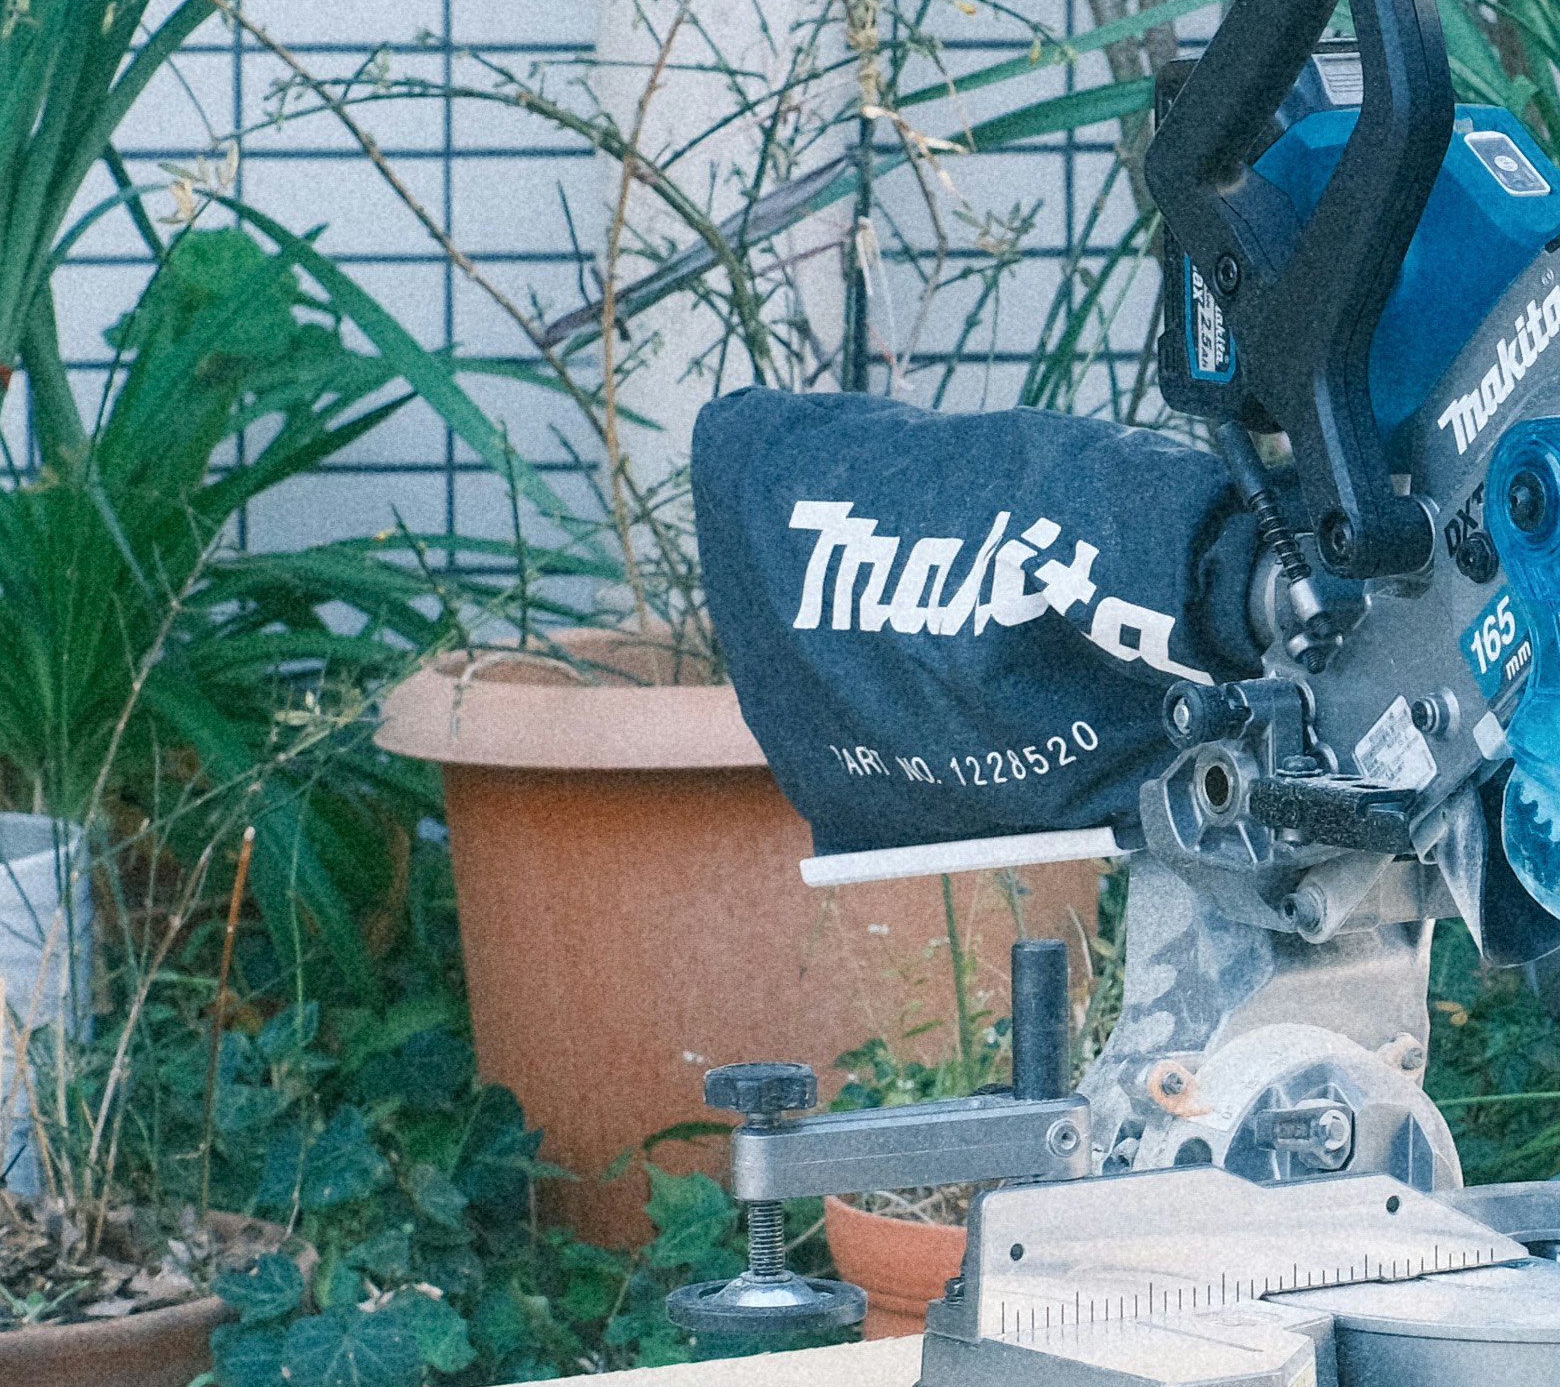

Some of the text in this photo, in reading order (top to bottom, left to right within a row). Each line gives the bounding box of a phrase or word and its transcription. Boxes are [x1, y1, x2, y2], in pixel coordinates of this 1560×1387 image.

[1471, 595, 1515, 674] 165
[1505, 640, 1532, 680] mm
[896, 756, 942, 785] NO.
[950, 721, 1098, 786] 1228520
